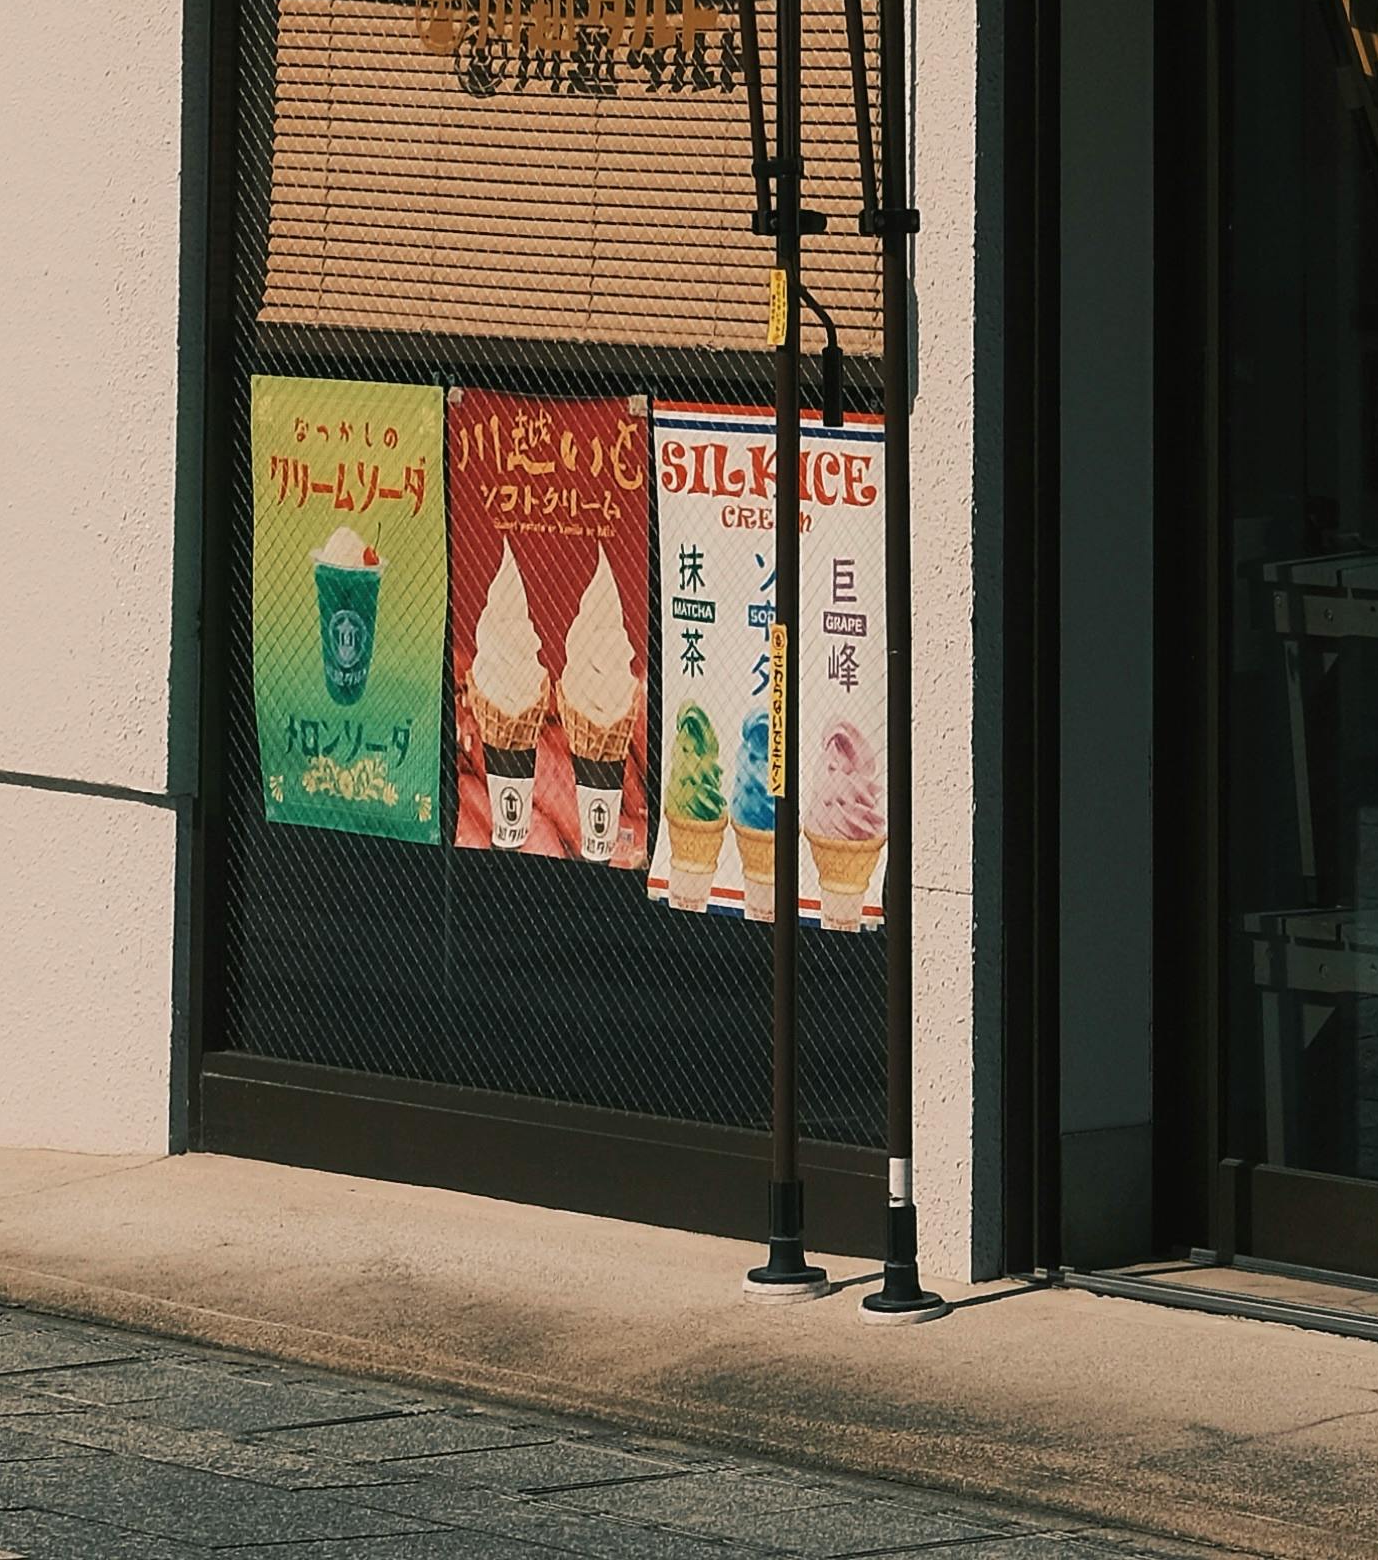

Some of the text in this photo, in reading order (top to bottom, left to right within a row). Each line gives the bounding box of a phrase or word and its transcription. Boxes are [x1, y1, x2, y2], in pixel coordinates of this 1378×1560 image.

[295, 417, 399, 450] なつかしの
[457, 407, 644, 490] 川越いも
[269, 455, 426, 518] クリームソーダ
[660, 440, 776, 500] SILK
[480, 484, 621, 521] ソフトクリーム
[673, 598, 714, 620] MATCHA
[825, 613, 863, 632] GRAPE
